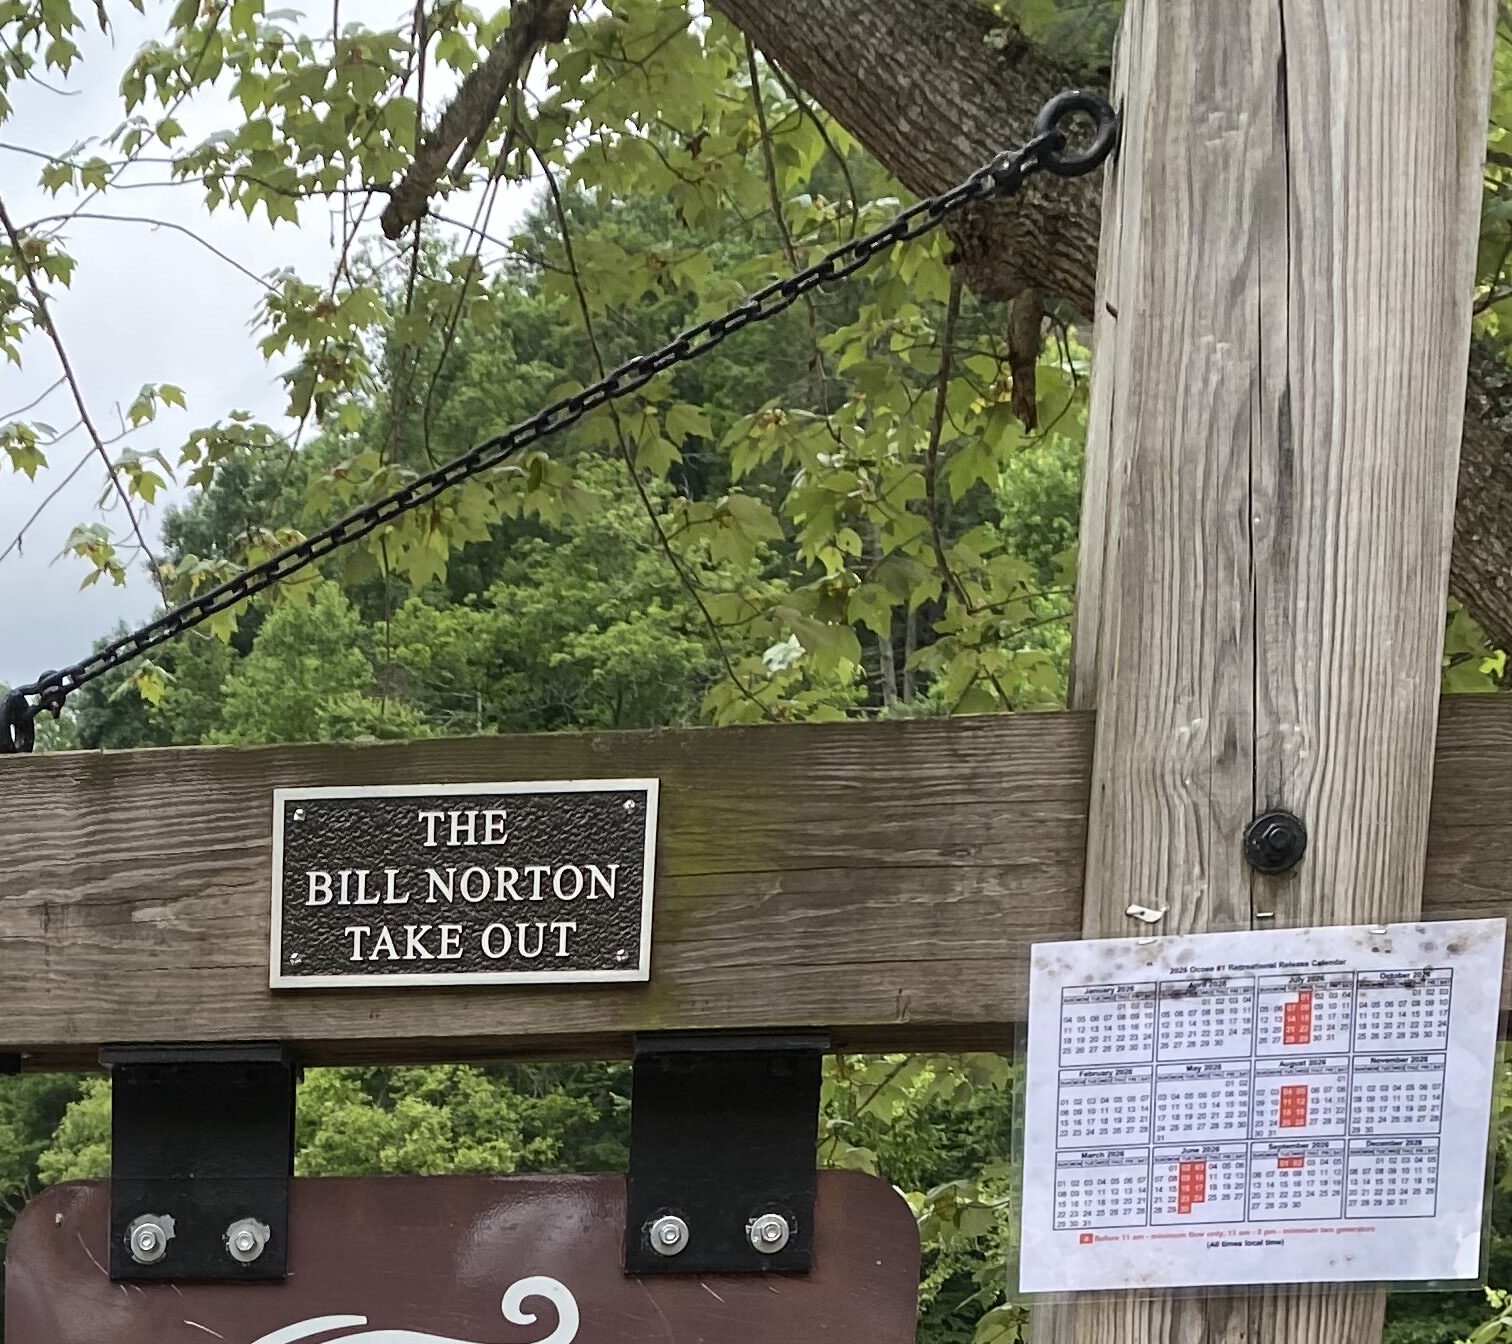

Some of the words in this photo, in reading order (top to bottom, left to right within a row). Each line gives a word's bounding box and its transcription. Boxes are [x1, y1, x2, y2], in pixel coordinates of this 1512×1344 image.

[418, 810, 507, 847] THE
[305, 870, 410, 906] BILL
[425, 864, 619, 903] NORTON
[345, 924, 464, 961] TAKE
[481, 921, 577, 959] OUT
[1288, 976, 1304, 984] July
[1188, 981, 1206, 990] April
[1278, 1060, 1306, 1068] August
[1370, 1056, 1408, 1064] November
[1079, 1069, 1112, 1078] February
[1268, 1143, 1308, 1152] September
[1366, 1139, 1402, 1147] December
